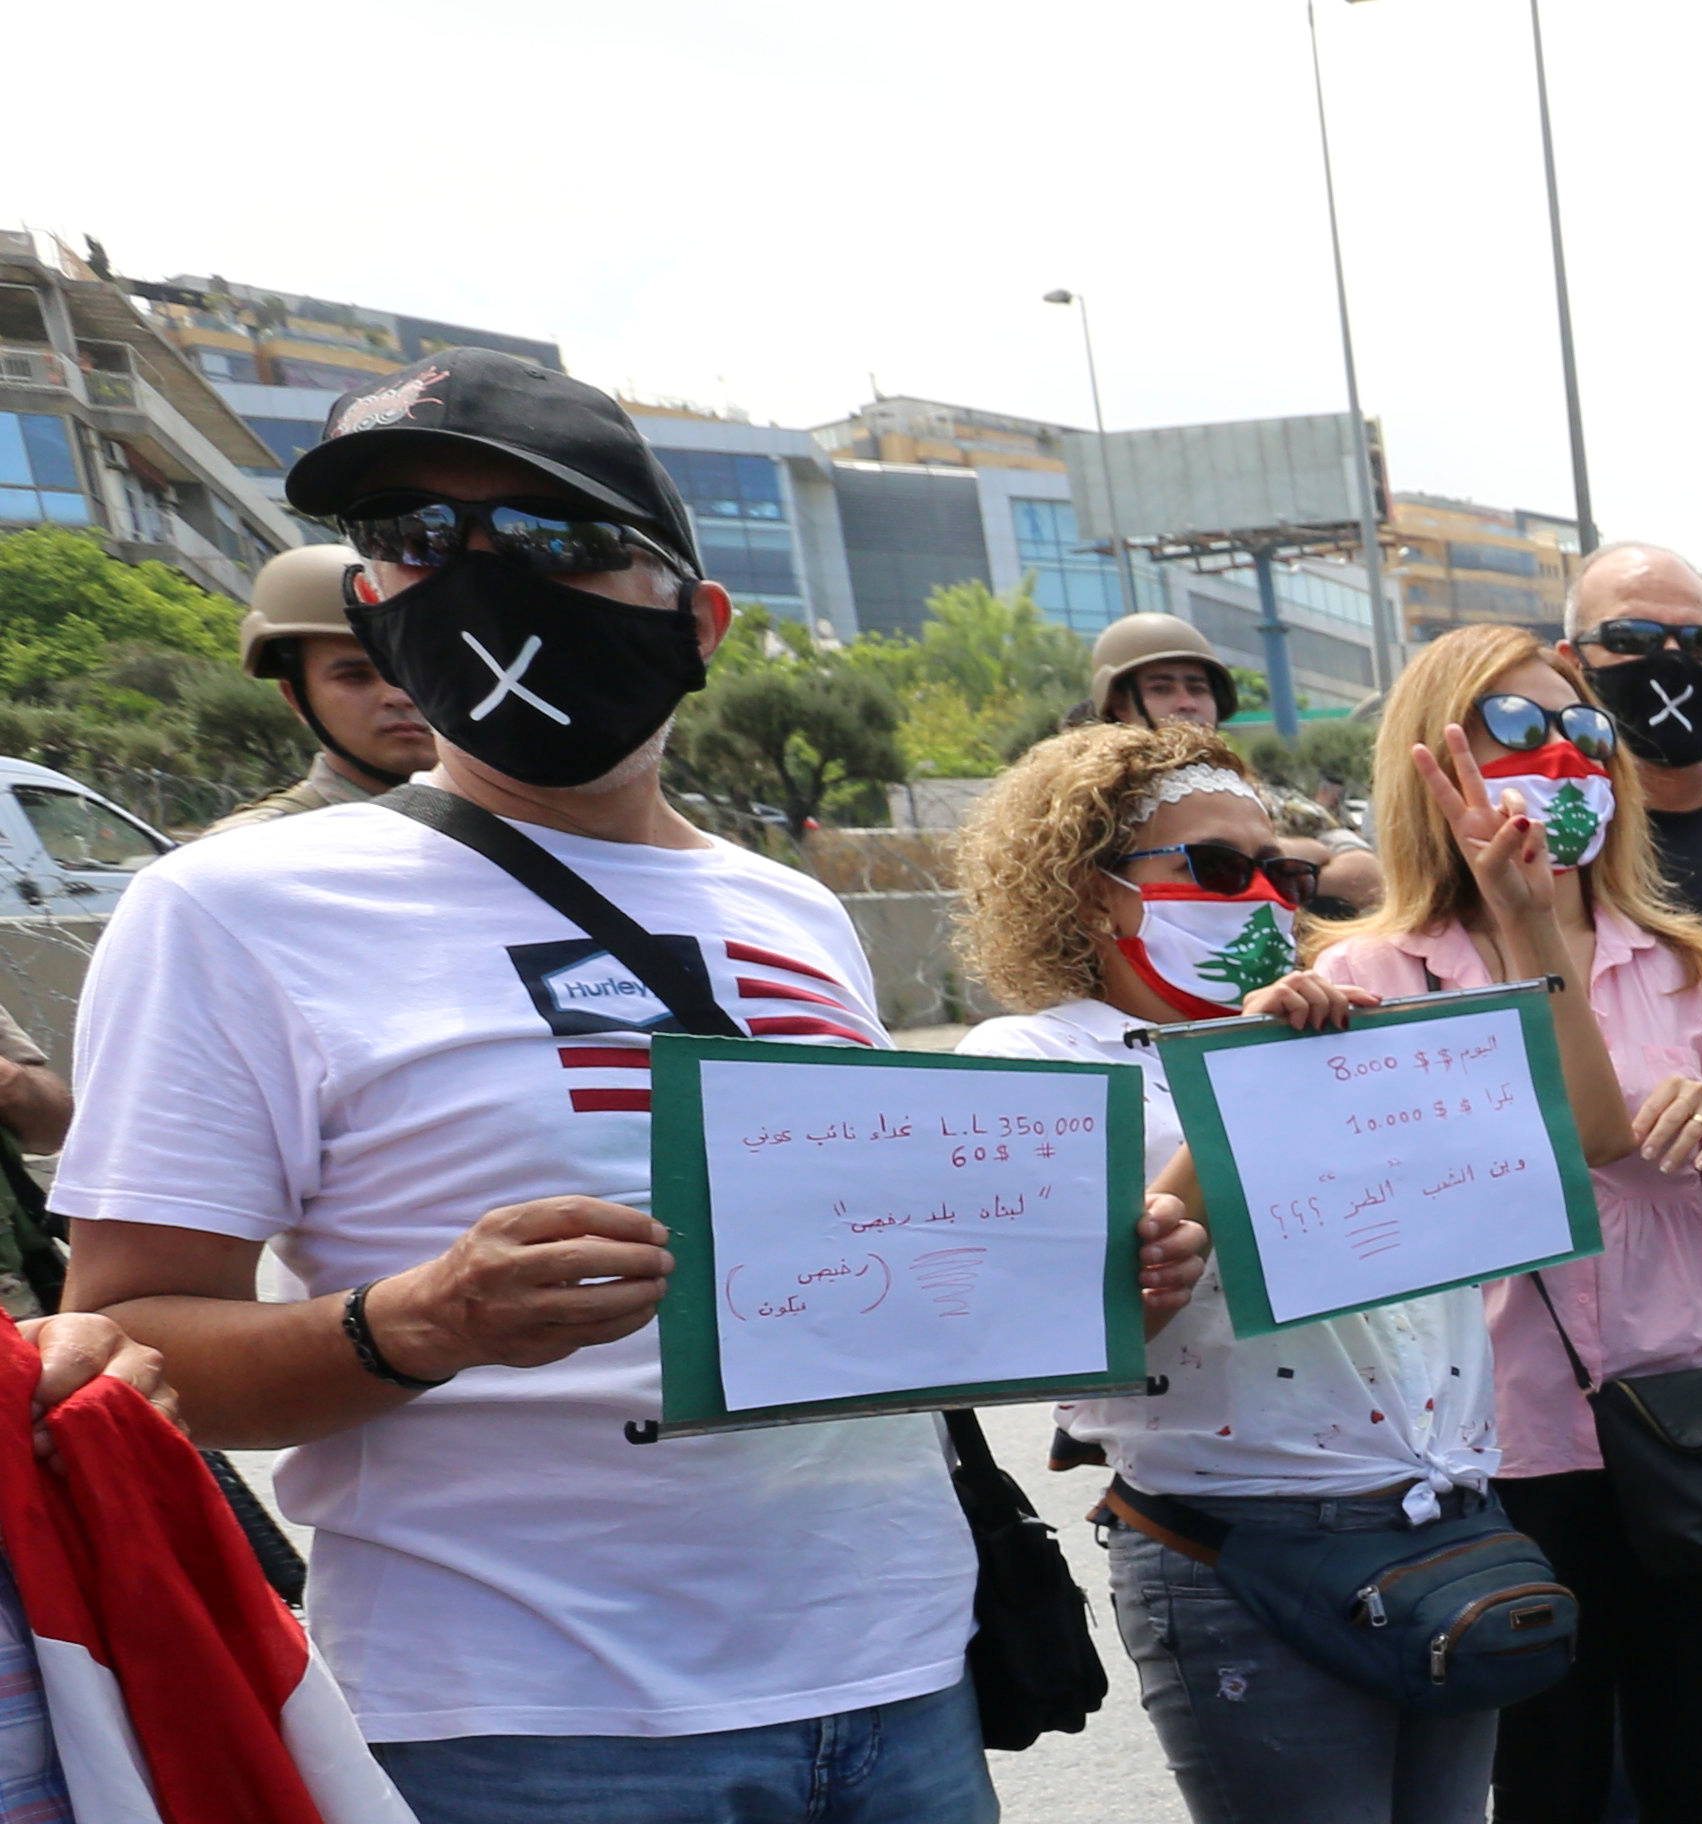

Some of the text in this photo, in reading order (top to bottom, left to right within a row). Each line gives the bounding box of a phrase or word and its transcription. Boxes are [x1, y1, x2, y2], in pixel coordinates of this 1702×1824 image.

[565, 977, 647, 998] Hurley
[1326, 1056, 1397, 1081] 8.000
[1460, 1035, 1497, 1075] اليوم
[805, 1121, 856, 1146] نائب
[1345, 1109, 1422, 1135] 10.000
[924, 1202, 956, 1224] بلد
